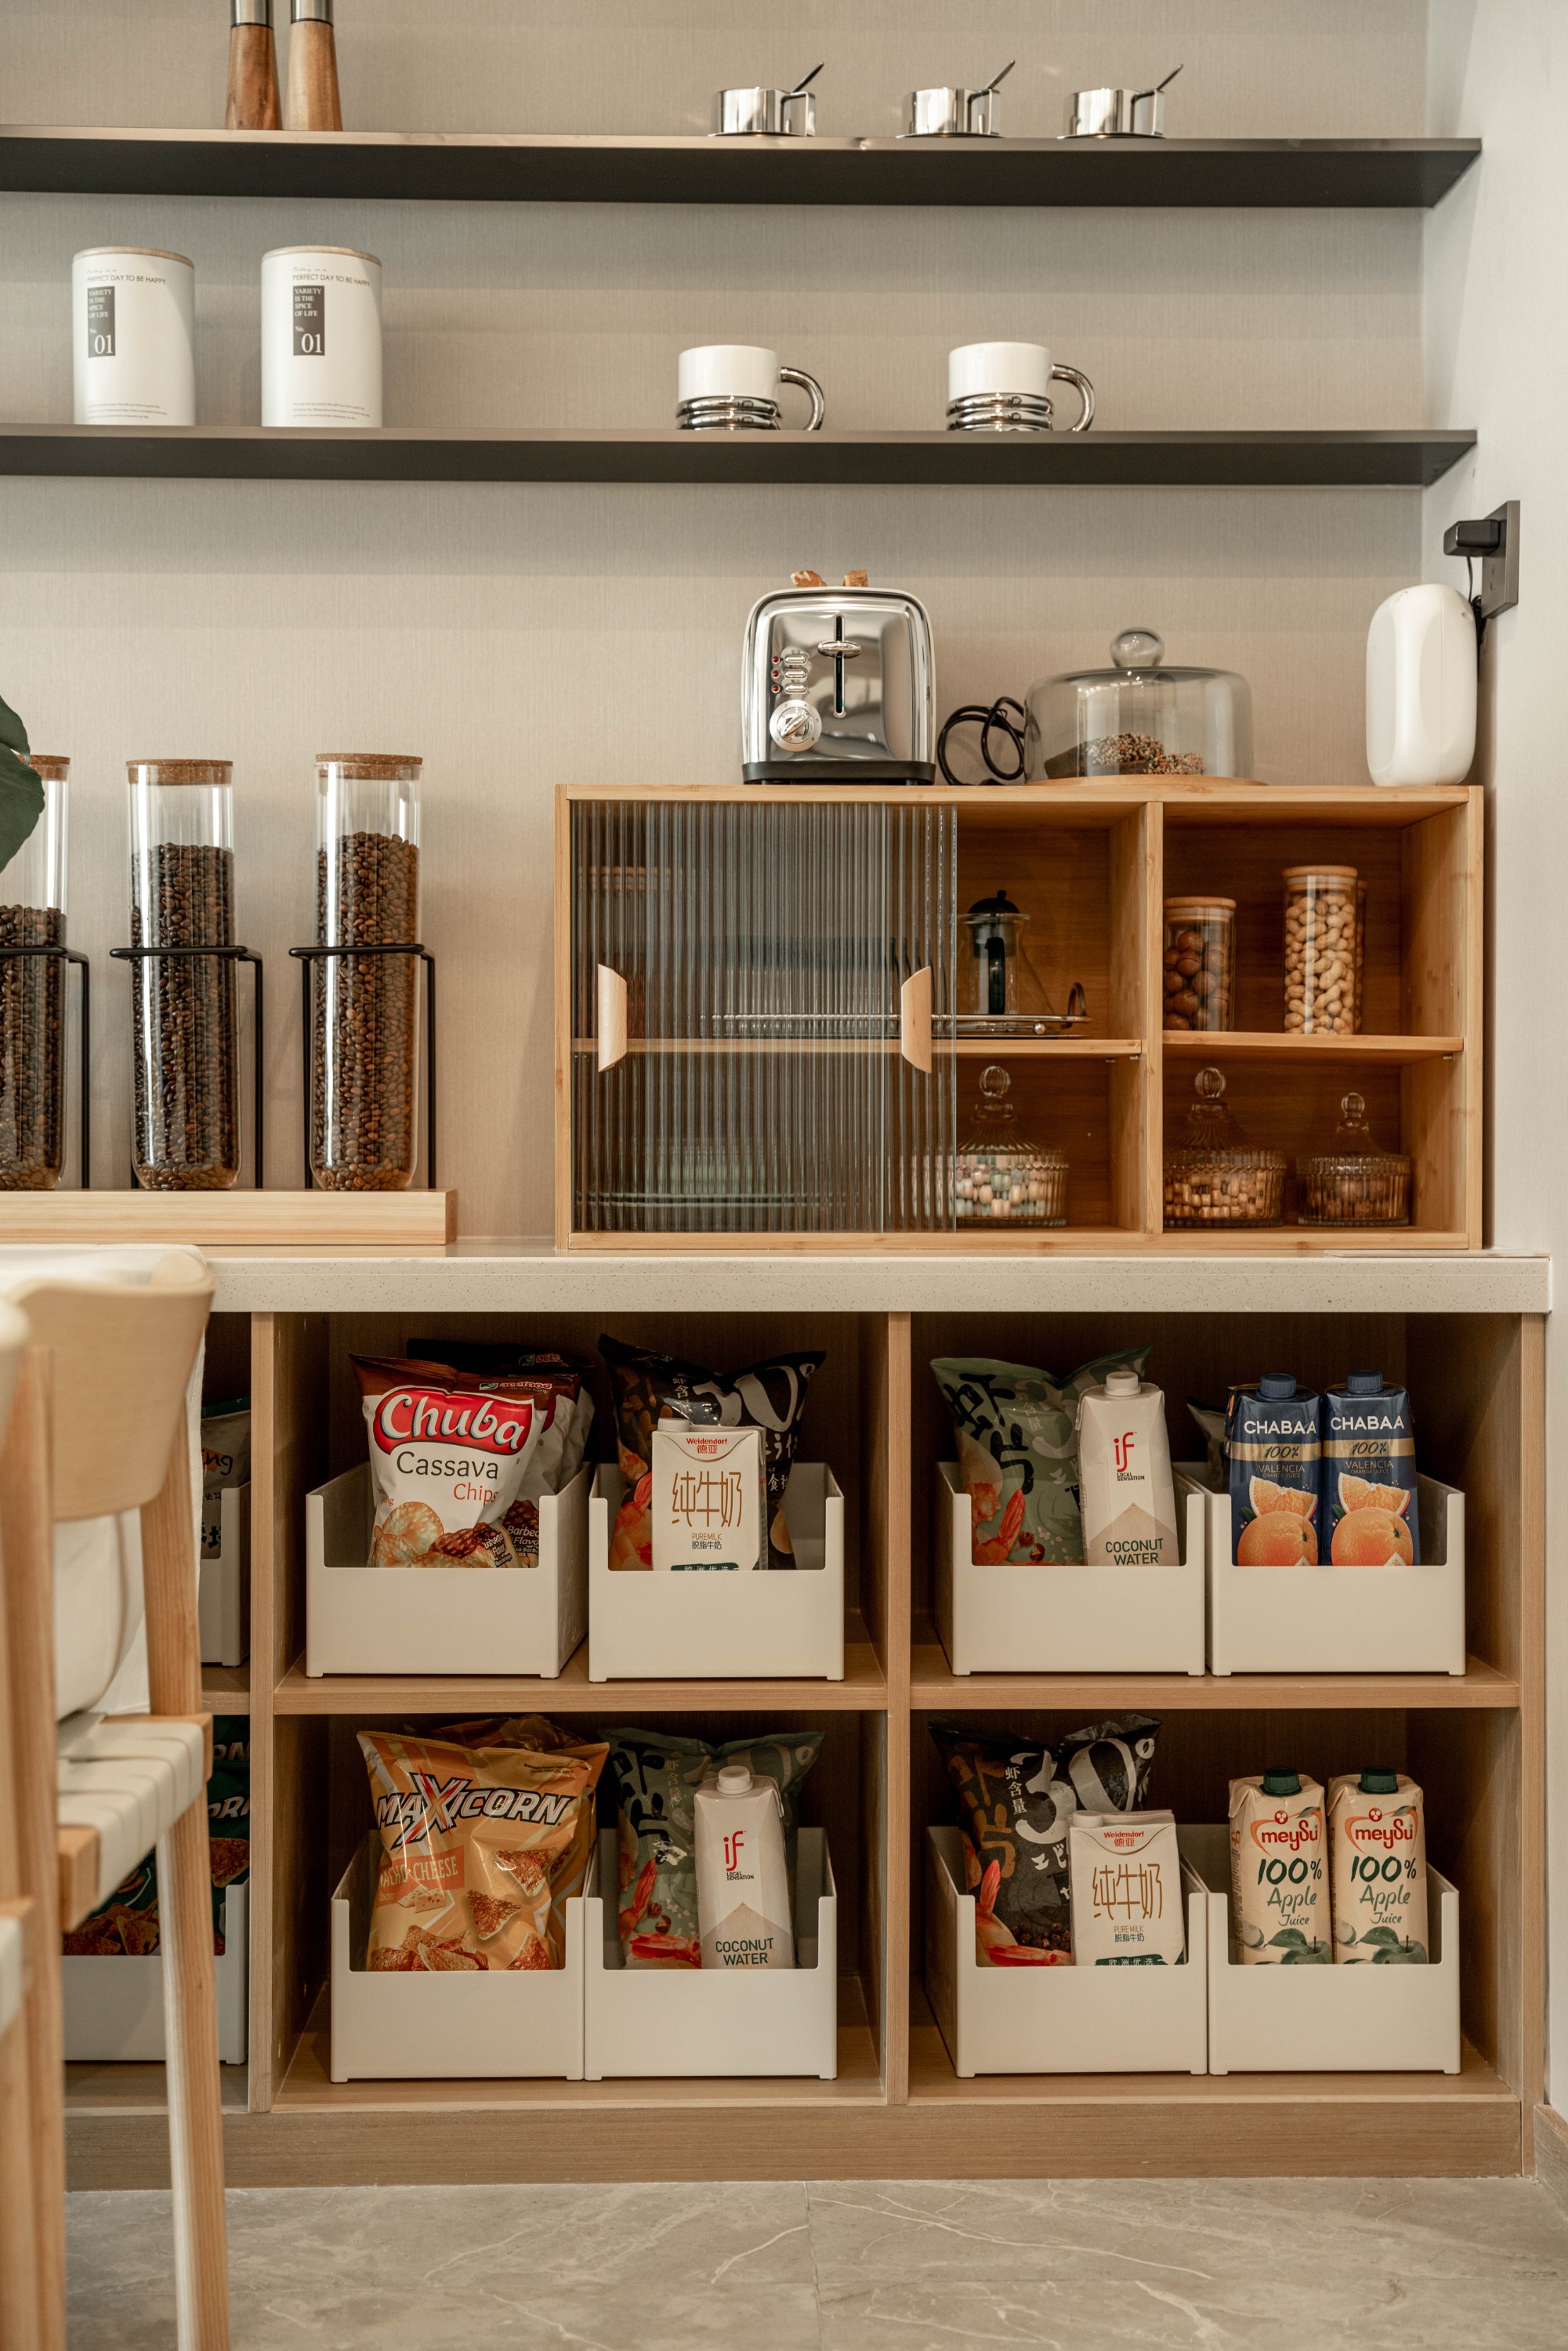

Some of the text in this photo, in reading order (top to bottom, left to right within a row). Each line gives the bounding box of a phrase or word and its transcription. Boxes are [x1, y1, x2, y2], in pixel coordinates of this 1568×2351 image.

[146, 277, 166, 285] HAPPY
[353, 278, 371, 287] HAPPY
[94, 334, 114, 354] 01
[301, 333, 323, 353] 01
[380, 1393, 526, 1451] Chuba
[1244, 1419, 1317, 1435] CHABAA
[1330, 1415, 1405, 1431] CHABAA
[696, 1445, 719, 1454] 德亚
[1114, 1432, 1135, 1473] if
[1264, 1445, 1301, 1458] 100%
[1350, 1441, 1388, 1455] 100%
[397, 1451, 498, 1480] Cassava
[1258, 1464, 1305, 1473] VALENCIA
[1345, 1460, 1394, 1469] VALENCIA
[453, 1482, 498, 1506] Chips
[672, 1470, 742, 1527] 纯牛奶
[507, 1525, 539, 1538] Barbeq
[691, 1532, 722, 1541] PURE MILK
[513, 1537, 539, 1545] Flavo
[691, 1541, 722, 1550] 脱脂牛奶
[1105, 1538, 1164, 1553] COCONUT
[1114, 1552, 1160, 1566] WATER
[1005, 1766, 1027, 1815] 虾含量
[378, 1766, 577, 1853] MAXICORN
[1103, 1831, 1145, 1839] Weidendorf
[1114, 1838, 1135, 1847] 德亚
[723, 1830, 744, 1872] if
[413, 1856, 458, 1882] CHEESE
[1258, 1857, 1323, 1886] 100%
[1350, 1856, 1417, 1882] 100%
[1092, 1863, 1163, 1920] 纯牛奶
[1360, 1884, 1411, 1912] Apple
[1266, 1886, 1317, 1914] Apple
[1278, 1913, 1310, 1926] Juice
[1370, 1911, 1403, 1925] Juice
[715, 1937, 774, 1953] COCONUT
[1114, 1933, 1145, 1943] 脱脂牛奶
[723, 1952, 769, 1966] WATER
